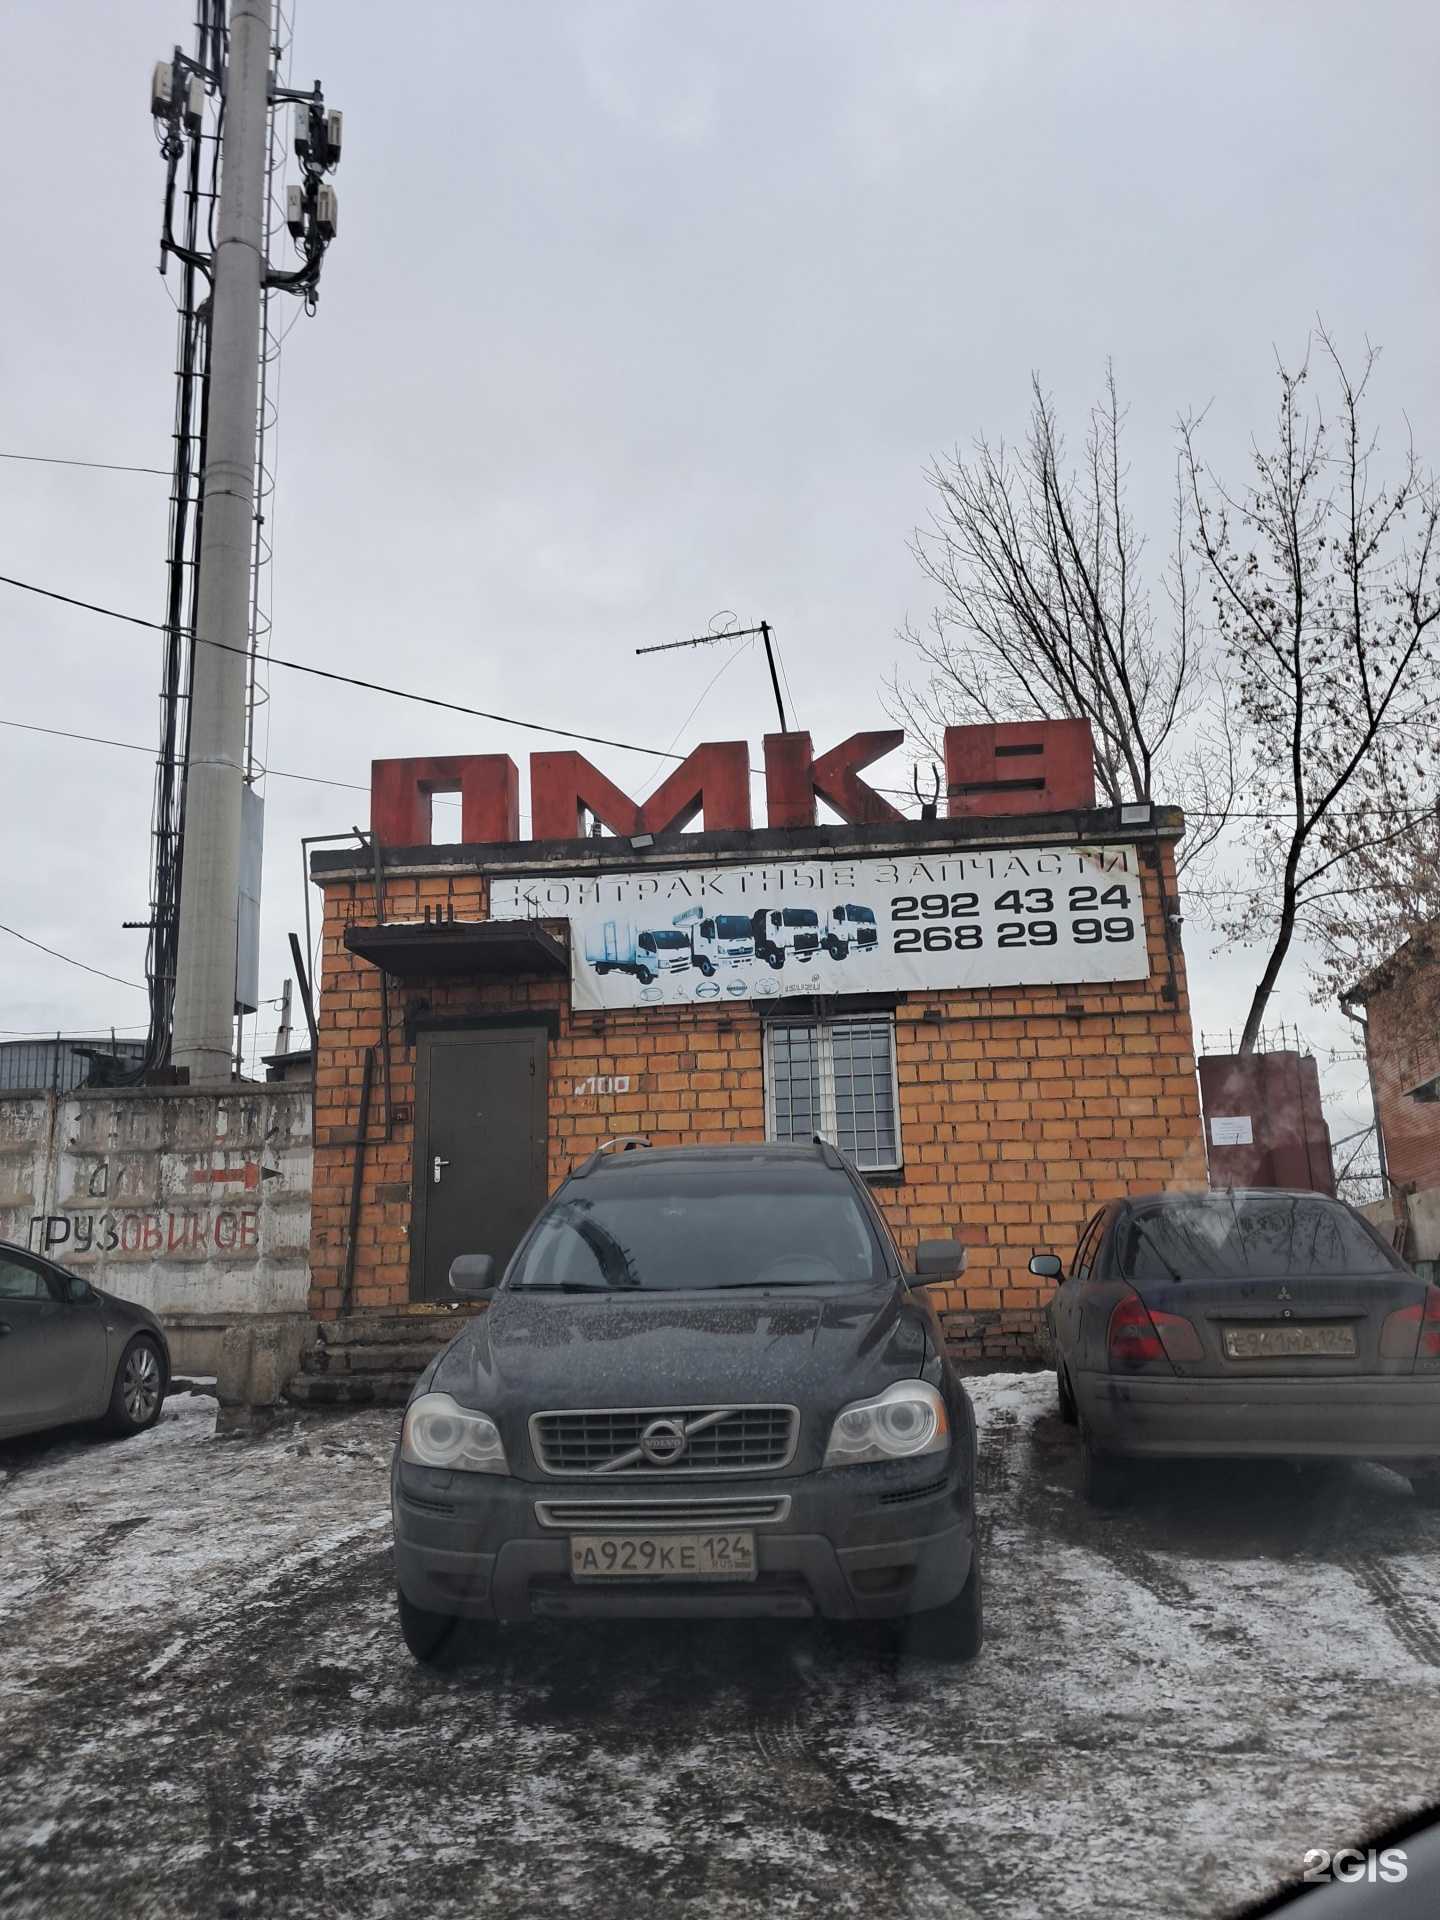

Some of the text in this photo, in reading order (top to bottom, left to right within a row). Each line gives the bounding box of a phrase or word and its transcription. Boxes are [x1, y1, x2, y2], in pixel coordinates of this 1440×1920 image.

[513, 852, 1130, 906] КОНТРАКТНЫЕ ЗАПЧАСТИ
[890, 884, 1131, 921] 292 43 24
[893, 917, 1134, 953] 268 29 99
